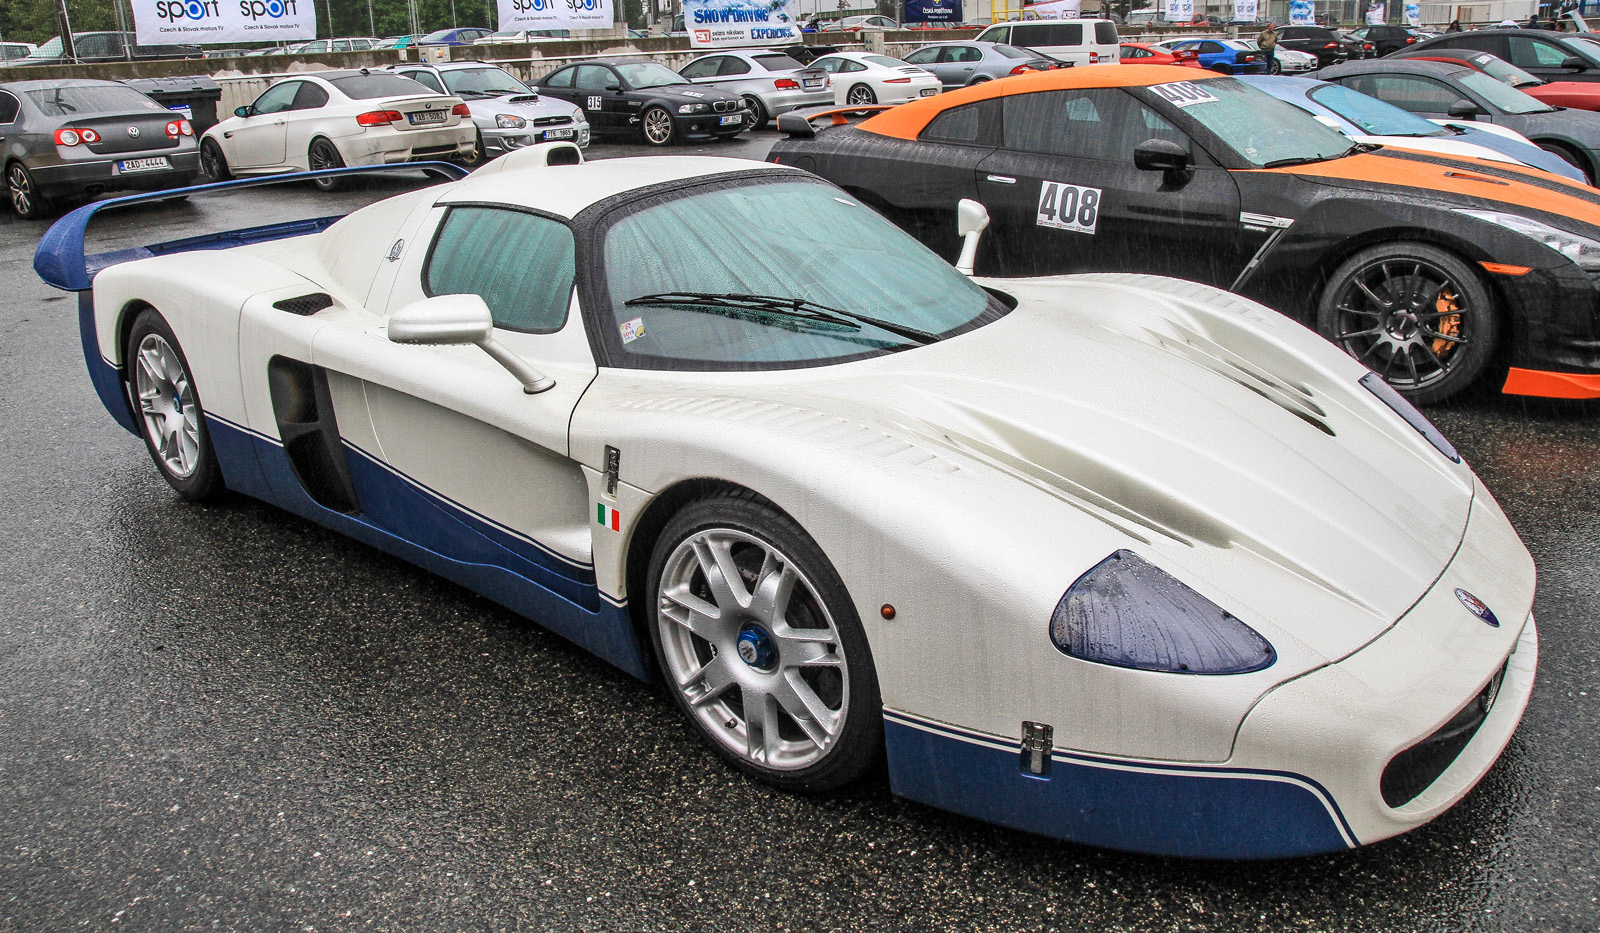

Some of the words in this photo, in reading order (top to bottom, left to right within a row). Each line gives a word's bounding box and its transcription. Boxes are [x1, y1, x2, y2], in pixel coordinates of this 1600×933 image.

[733, 7, 769, 23] DRIVING
[751, 27, 795, 40] EXPERIENCE
[1153, 82, 1212, 103] 408
[588, 97, 601, 109] 315
[125, 161, 141, 170] 2AD
[145, 158, 164, 168] 4444
[1039, 183, 1099, 227] 408
